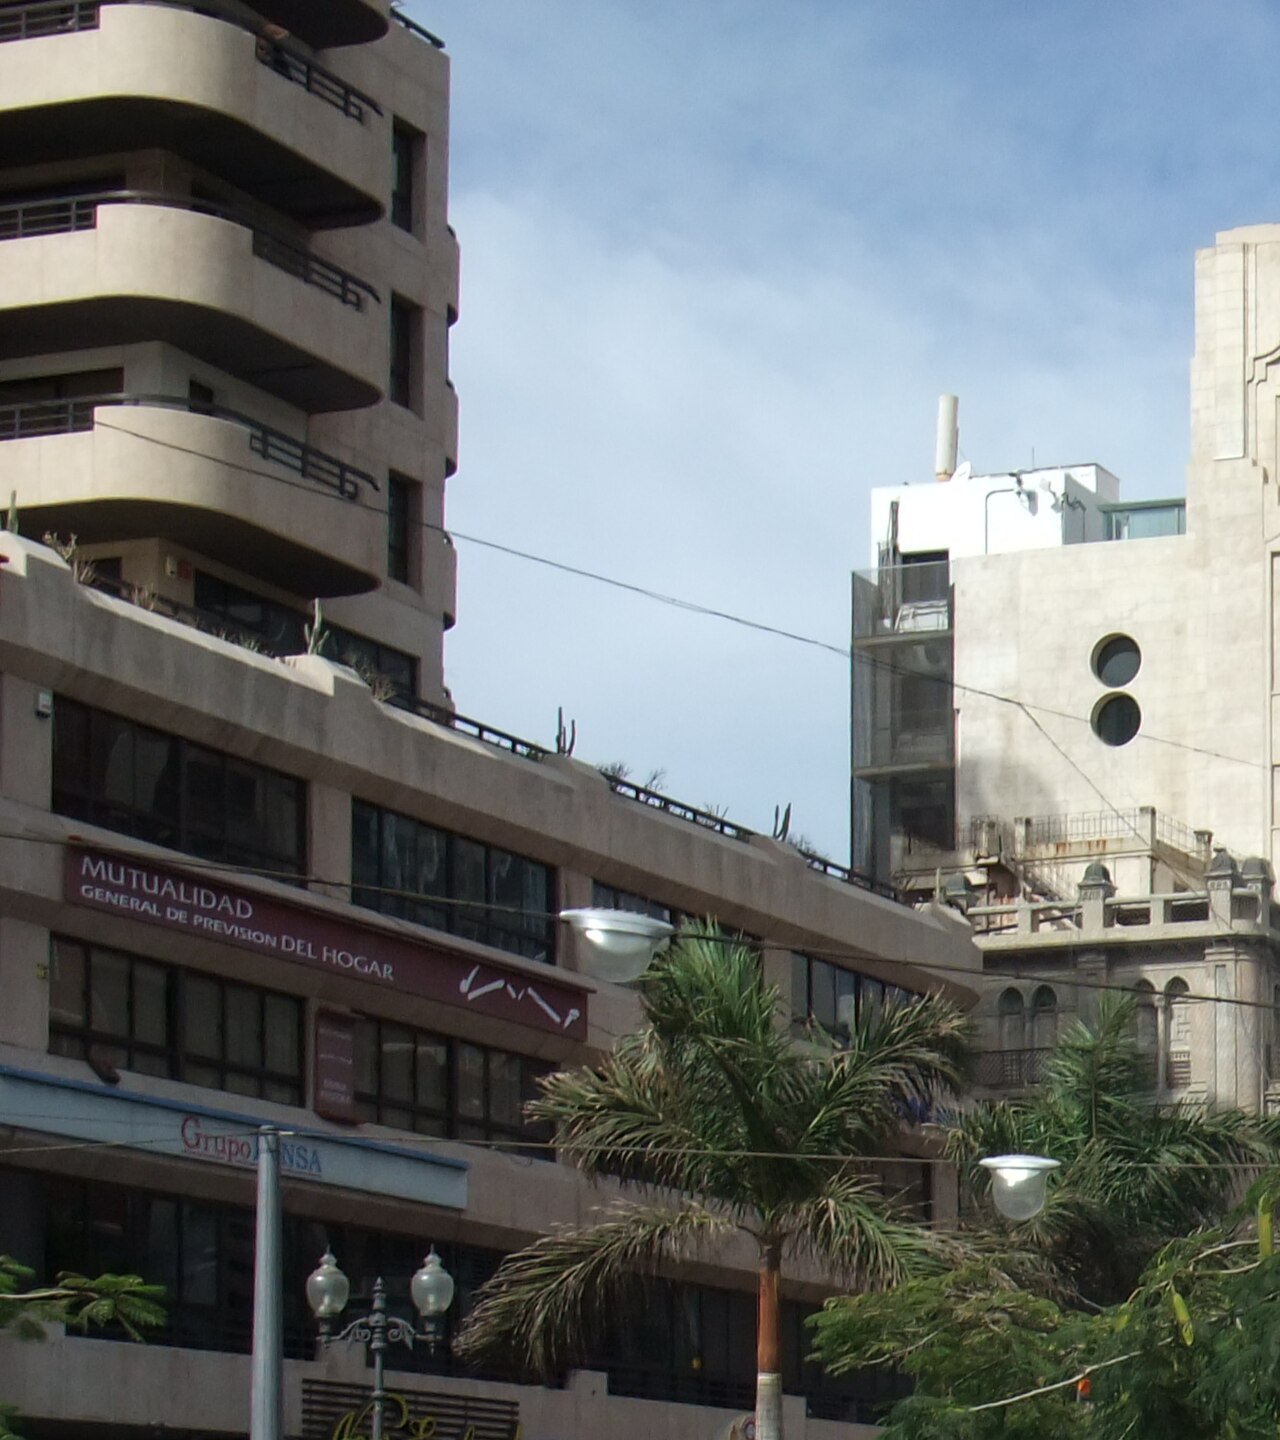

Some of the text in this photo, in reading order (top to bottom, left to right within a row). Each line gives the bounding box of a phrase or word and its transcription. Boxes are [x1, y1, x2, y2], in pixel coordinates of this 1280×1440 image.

[81, 856, 254, 919] MUTUALIDAD
[80, 884, 394, 981] GENERAL DE PREVISION DEL HOGAR
